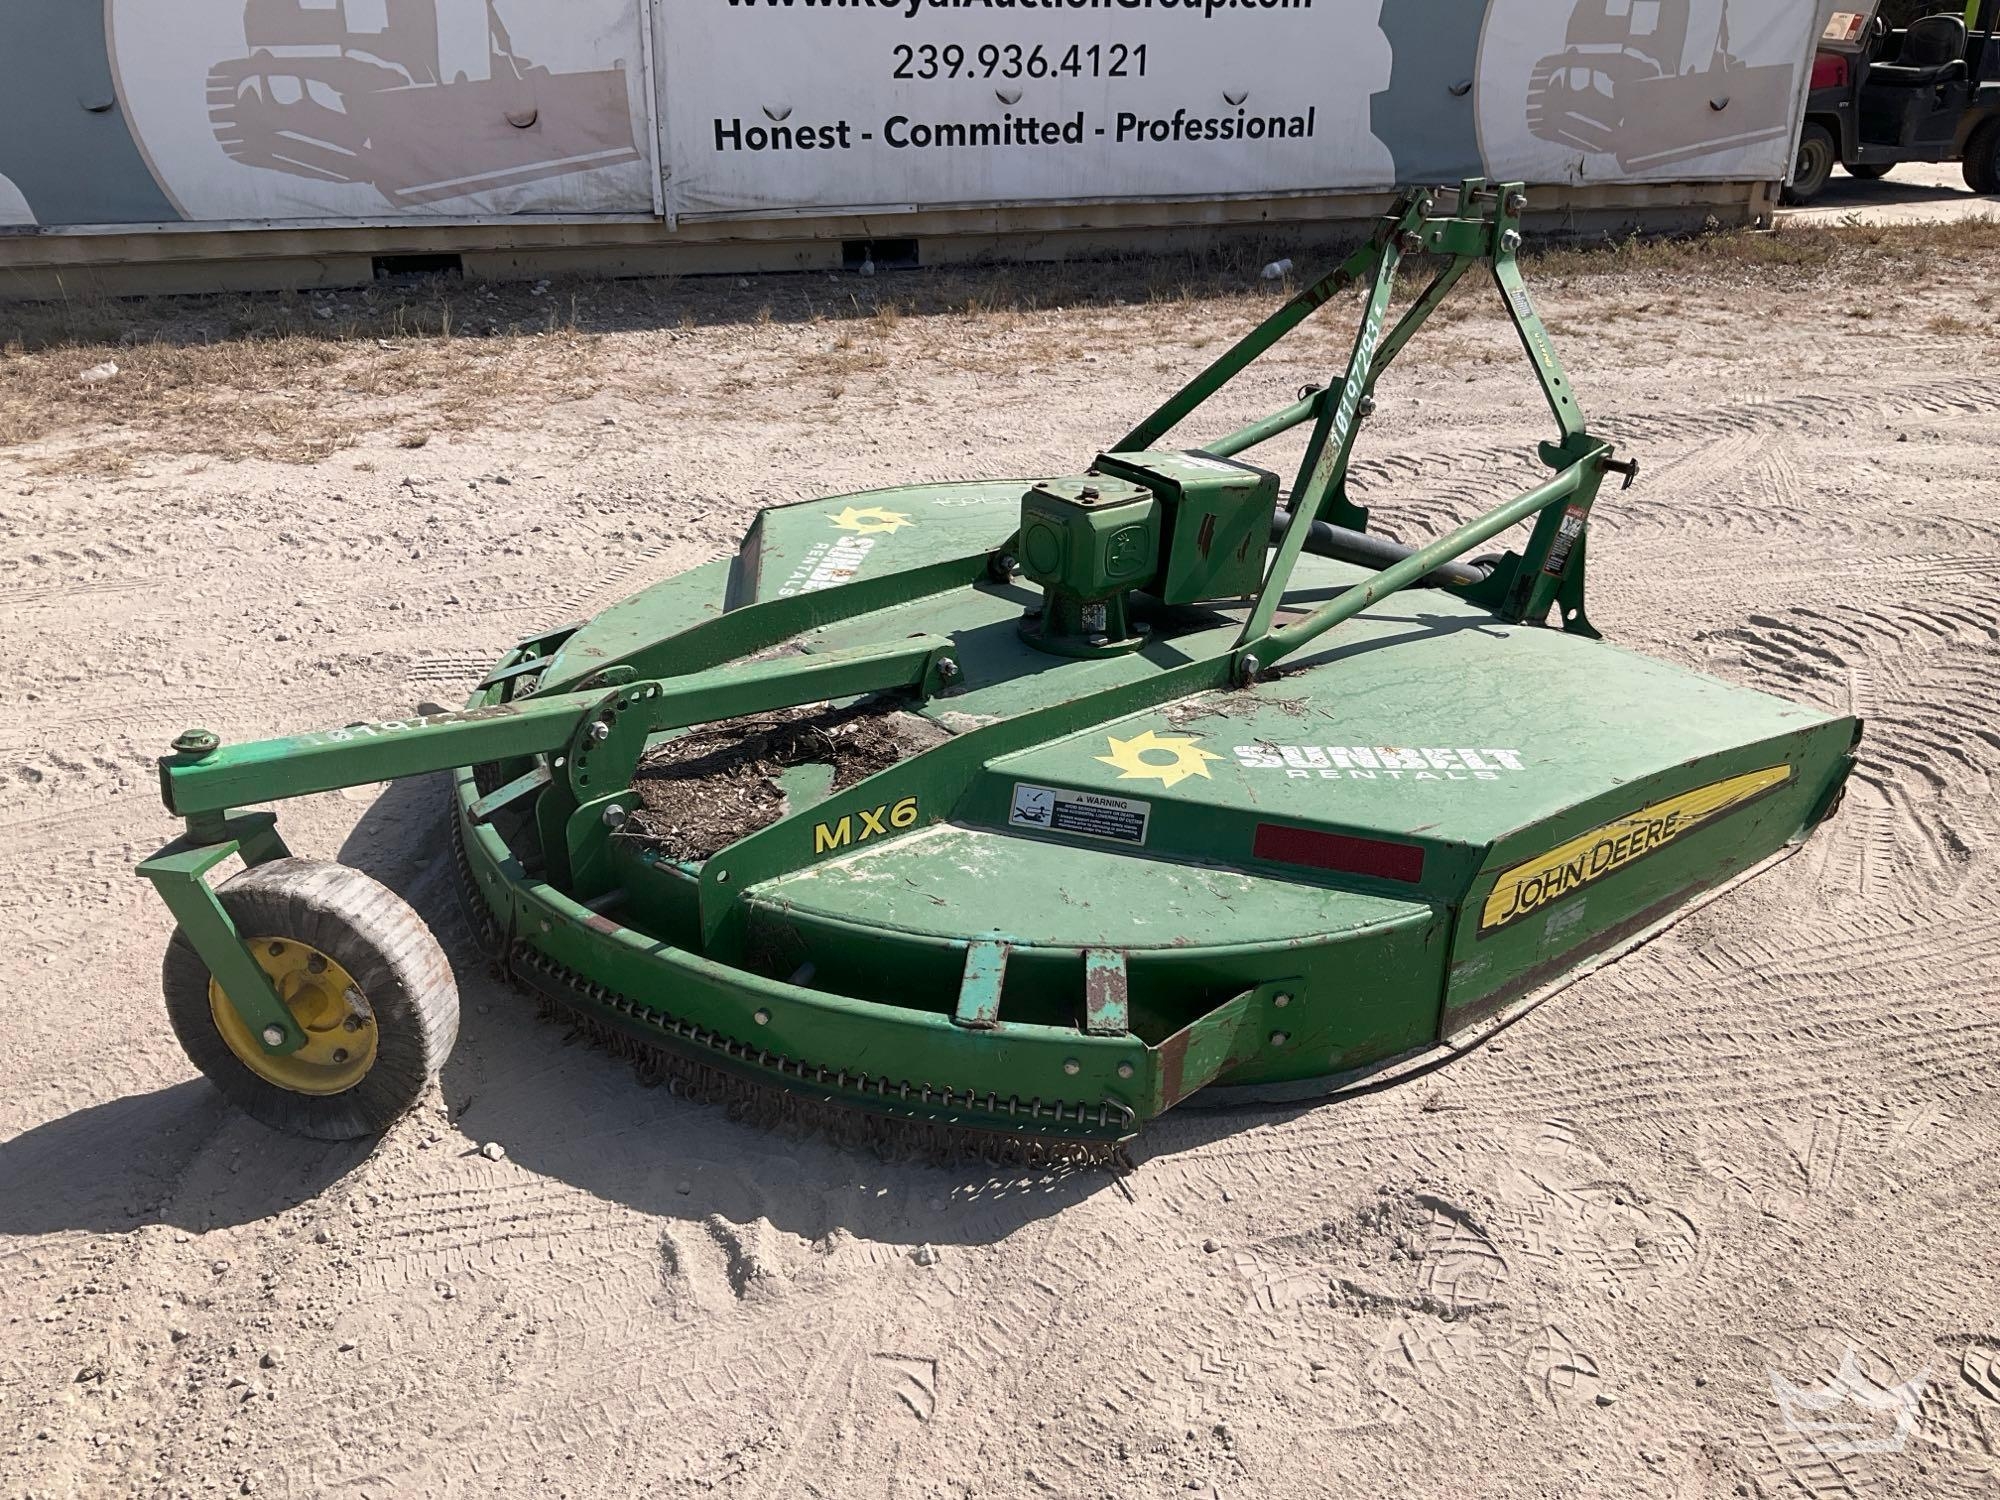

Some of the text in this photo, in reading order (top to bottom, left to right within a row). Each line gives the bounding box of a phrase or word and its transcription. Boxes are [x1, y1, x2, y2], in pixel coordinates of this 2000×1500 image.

[893, 43, 1147, 80] 239.936.4121
[713, 117, 851, 151] Honest
[883, 111, 1084, 148] Committed
[1116, 107, 1316, 143] Professional
[778, 542, 830, 596] RENTALS
[1232, 744, 1526, 771] SUNBELT
[1286, 768, 1500, 781] RENTALS
[1086, 796, 1128, 810] WARNING
[815, 796, 918, 855] MX6
[1501, 810, 1682, 921] JOHN DEERE
